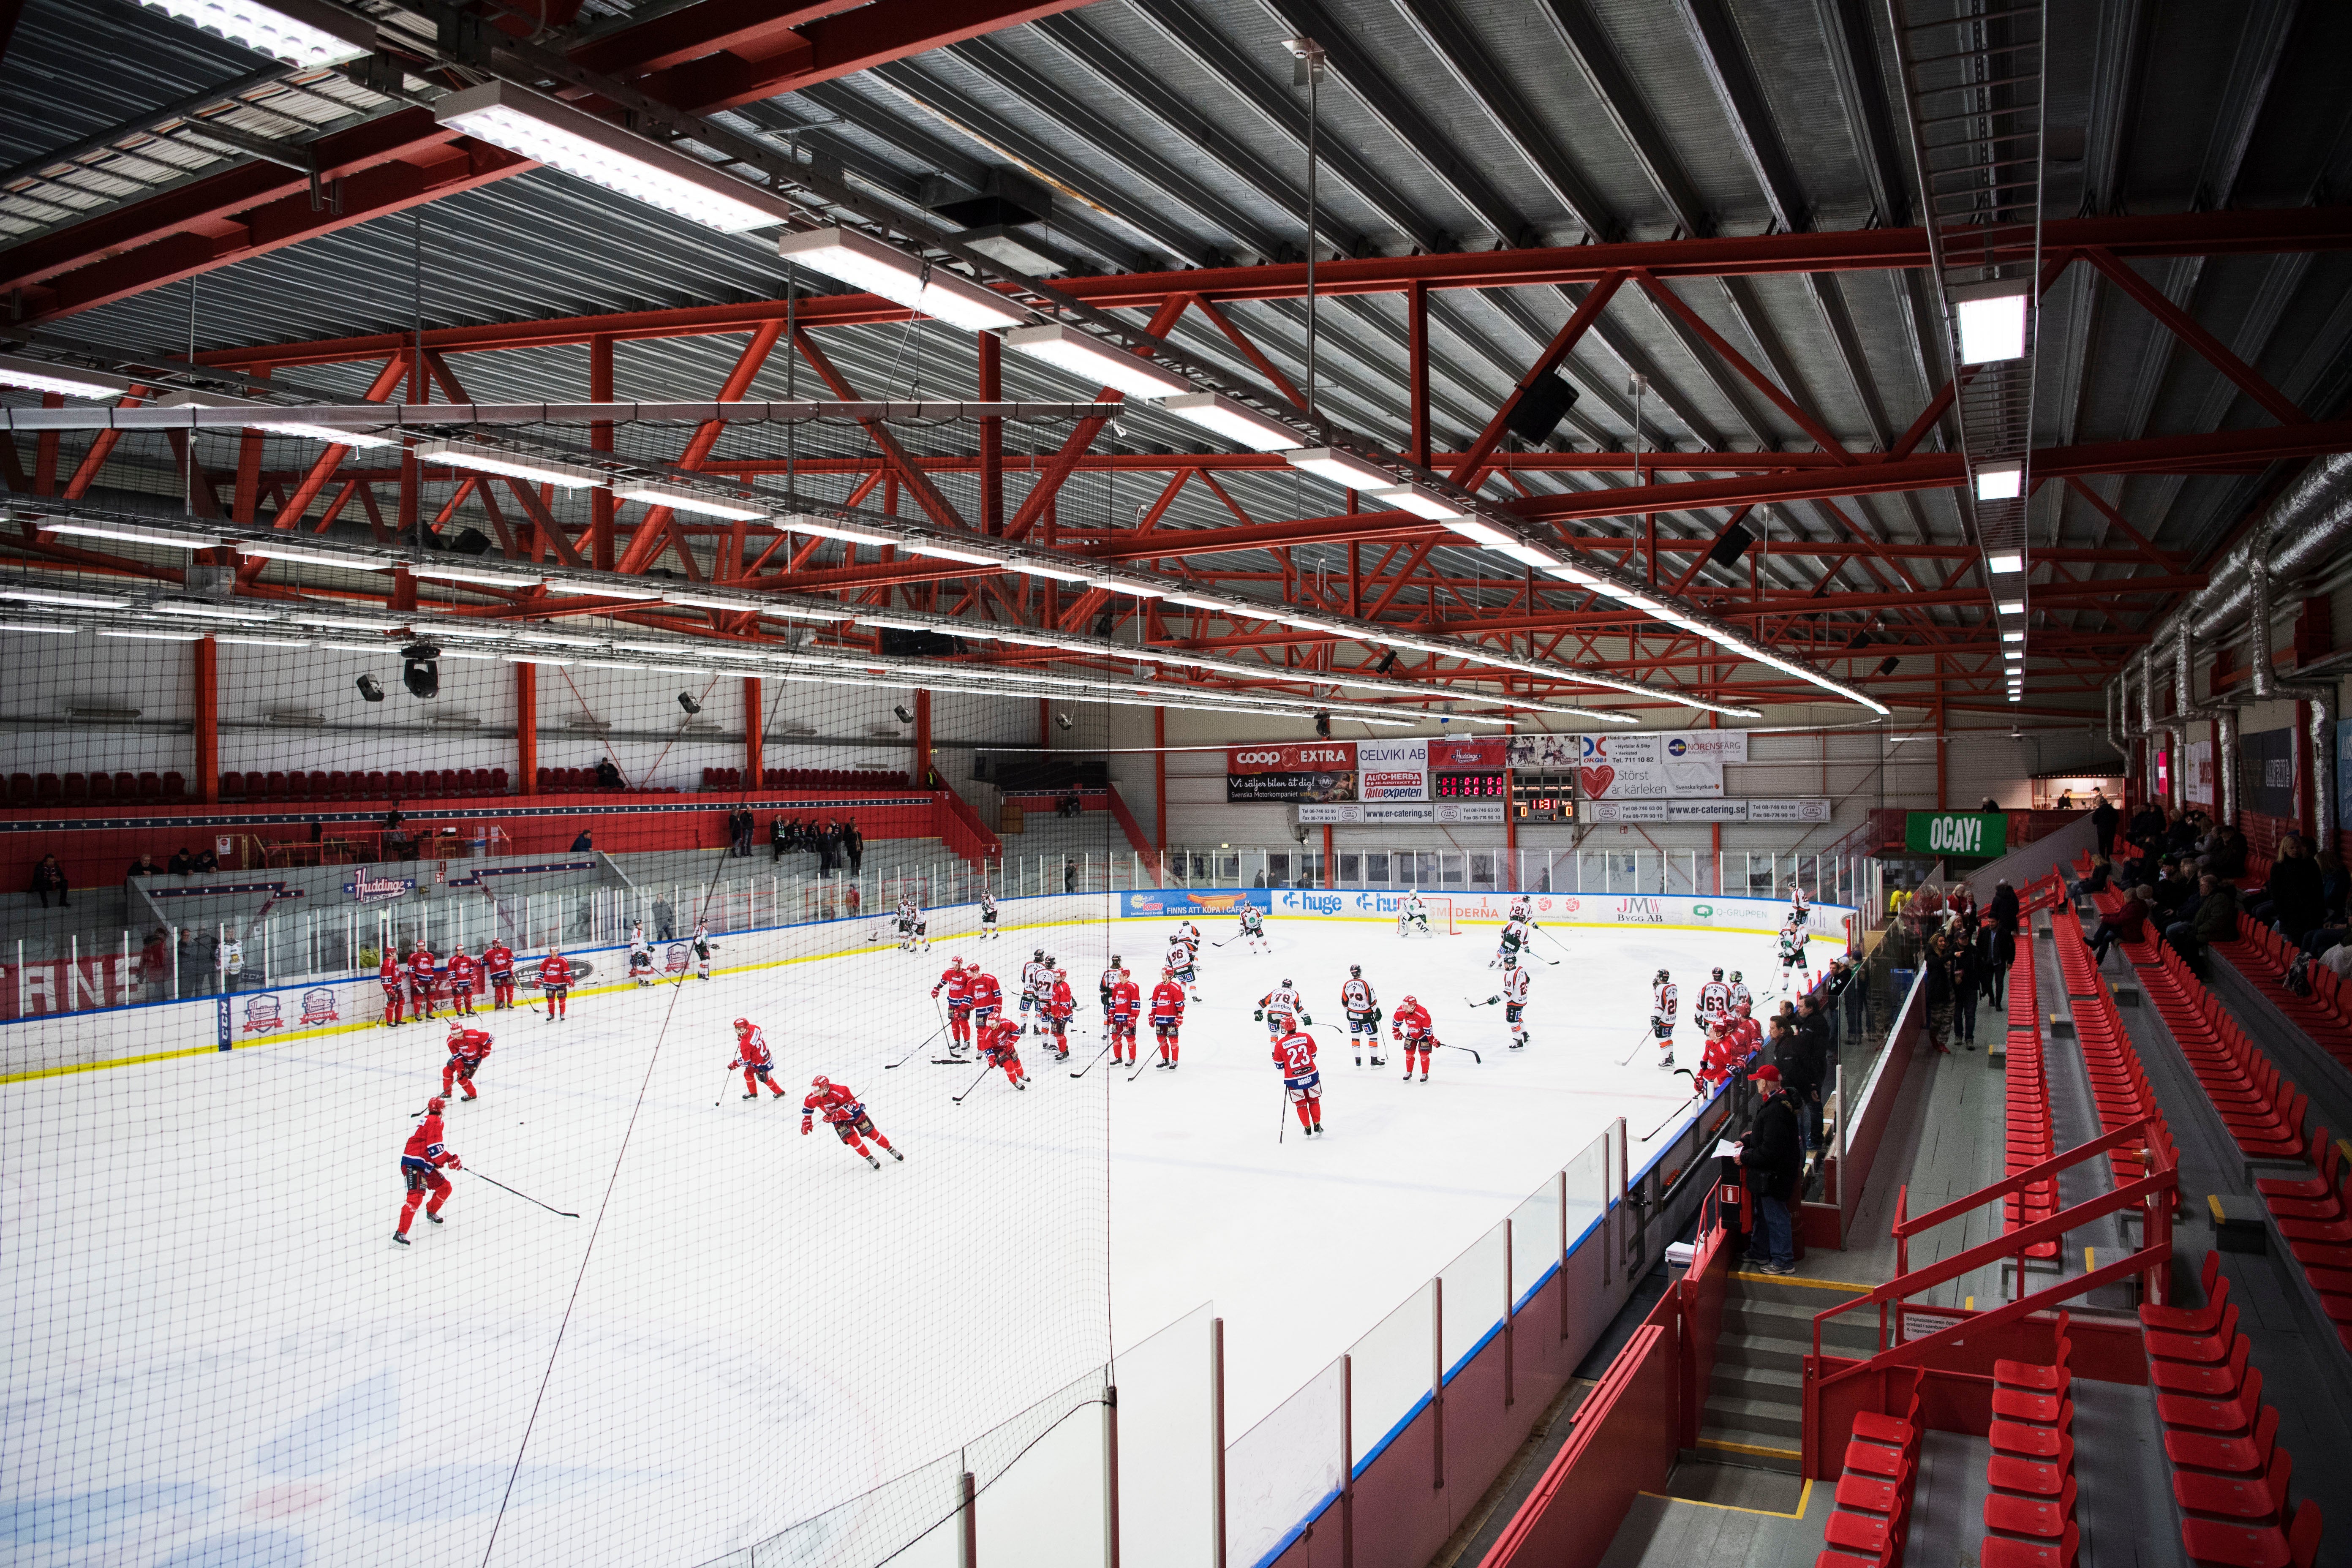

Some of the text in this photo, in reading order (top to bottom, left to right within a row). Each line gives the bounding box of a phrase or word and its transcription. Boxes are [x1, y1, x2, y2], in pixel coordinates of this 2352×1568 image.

[1237, 751, 1280, 765] coop
[1301, 750, 1346, 762] EXTRA
[1360, 749, 1426, 760] CELVIKI AB
[1456, 749, 1478, 762] Huddinge
[1367, 773, 1420, 781] AUTO-HERBA
[1618, 770, 1648, 780] Störst
[1230, 776, 1315, 791] Vi säljer bilen åt dig!
[1612, 784, 1666, 794] är kärleken
[1364, 787, 1422, 799] Autoexperten
[1532, 799, 1557, 809] 11:31
[1367, 809, 1432, 818] www.er-catering.se
[1521, 806, 1527, 817] 0
[1565, 806, 1573, 817] 0
[1669, 805, 1745, 815] www.er-catering.se
[1930, 816, 1981, 852] OCAY!
[355, 867, 406, 901] Huddinge
[364, 894, 392, 903] HOCKEY
[1303, 892, 1342, 915] huge
[1481, 896, 1488, 907] 1
[1143, 903, 1163, 911] KORV
[1167, 906, 1187, 915] FINNS
[1203, 905, 1220, 913] KÖPA
[1515, 906, 1524, 915] 21
[1617, 898, 1662, 914] JMW
[1716, 908, 1767, 918] Q-GRUPPEN
[1416, 922, 1429, 933] AVT
[0, 956, 147, 1013] ANS
[1037, 981, 1051, 992] 27
[1706, 996, 1724, 1012] 63
[1284, 1039, 1307, 1047] TermoRör
[1287, 1045, 1310, 1069] 23
[1297, 1076, 1312, 1086] ROSÉN
[1906, 1316, 1945, 1325] Sittplatsläktaren
